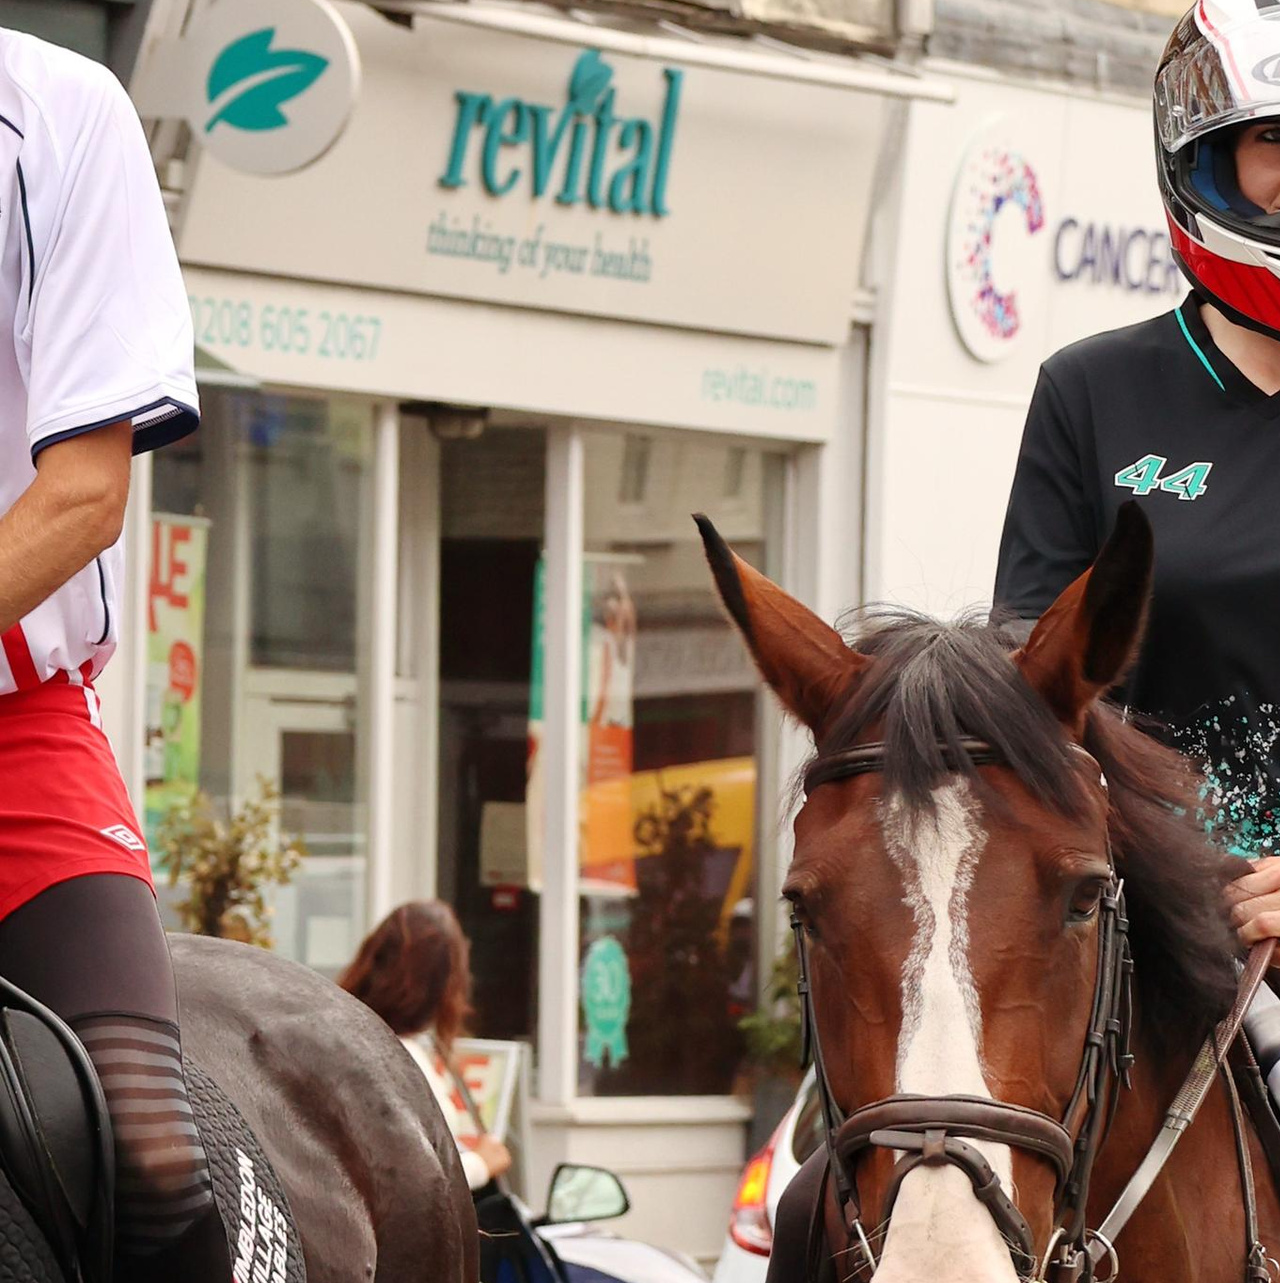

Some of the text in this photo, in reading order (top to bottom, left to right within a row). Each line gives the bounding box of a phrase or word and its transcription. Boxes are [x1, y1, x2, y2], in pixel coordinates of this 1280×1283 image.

[437, 49, 684, 219] revital
[427, 211, 516, 274] thinking
[537, 239, 589, 279] your
[590, 230, 653, 283] health
[261, 304, 309, 356] 605
[317, 310, 382, 361] 2067
[701, 362, 818, 410] revital.com
[1114, 453, 1214, 500] 44
